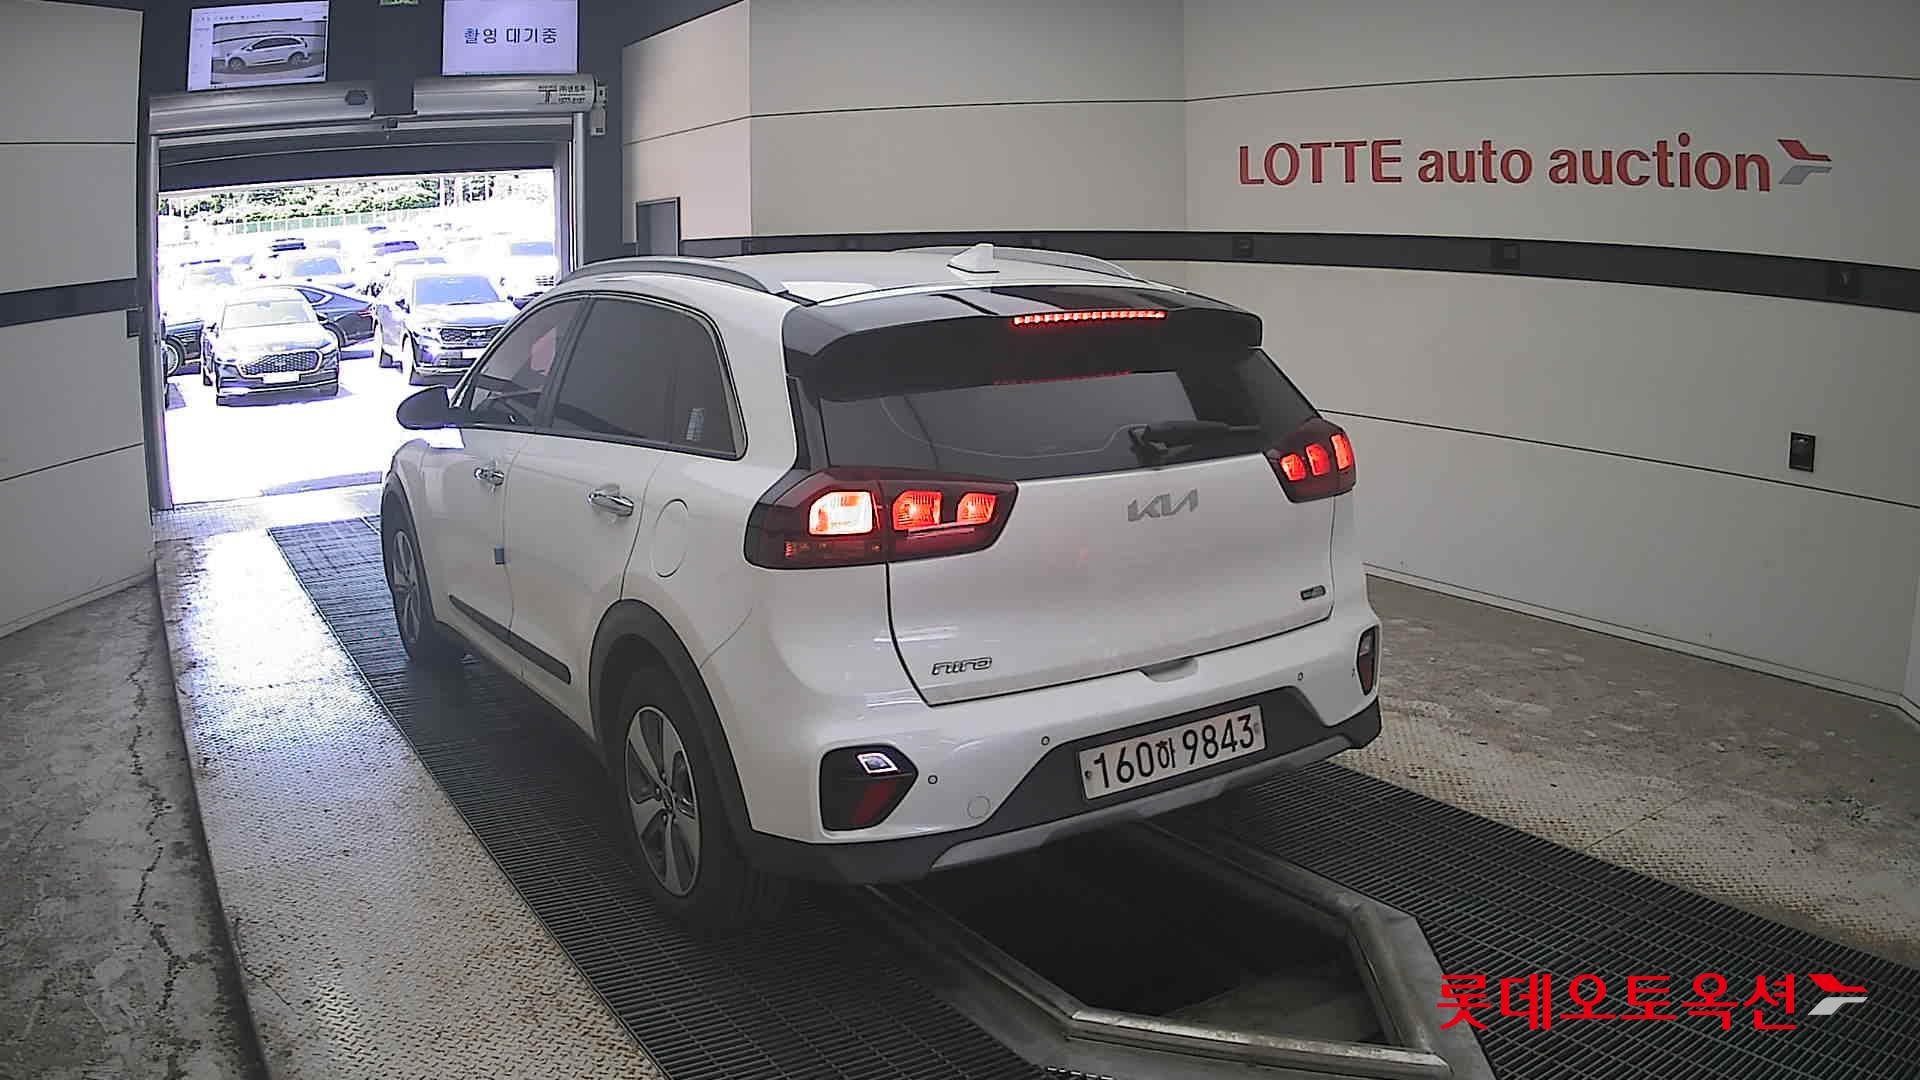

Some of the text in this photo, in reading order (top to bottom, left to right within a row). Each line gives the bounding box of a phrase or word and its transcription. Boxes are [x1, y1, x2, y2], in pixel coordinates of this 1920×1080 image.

[506, 27, 558, 44] 대기중
[1239, 132, 1771, 192] LOTTE auto auction
